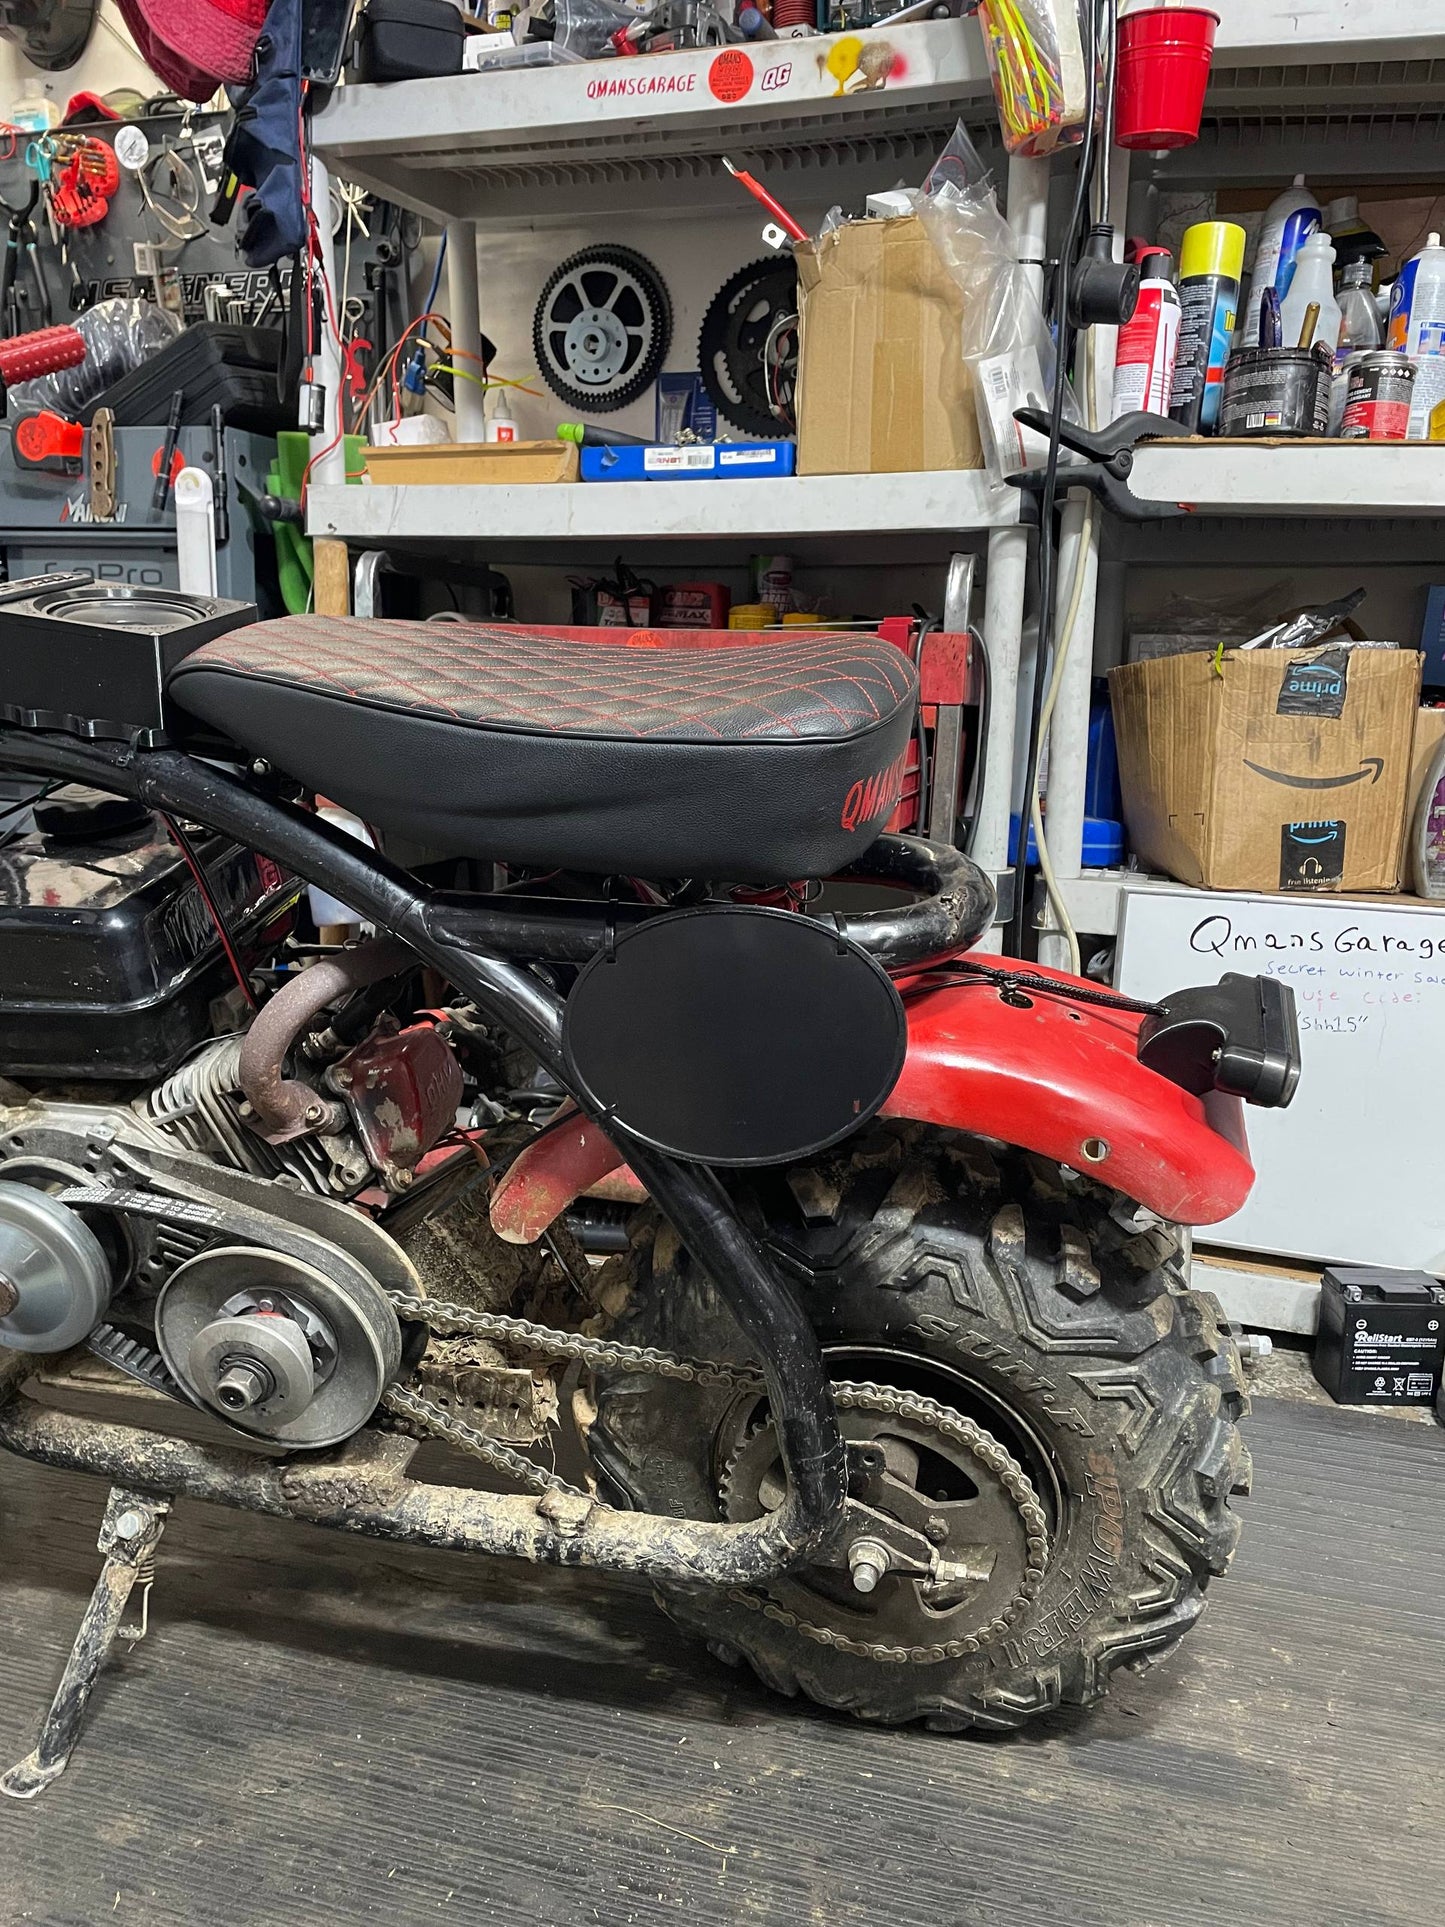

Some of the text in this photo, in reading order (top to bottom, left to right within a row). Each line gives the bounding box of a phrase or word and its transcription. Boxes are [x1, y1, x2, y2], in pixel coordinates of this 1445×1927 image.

[586, 73, 697, 100] QMANSGARAGE
[760, 62, 793, 92] QG
[1289, 680, 1341, 698] prime
[1190, 915, 1445, 959] Qmans Garage
[1339, 967, 1404, 982] winter
[124, 1201, 142, 1209] THIS
[177, 1213, 209, 1223] ENGINE
[129, 1197, 147, 1205] THIS
[182, 1208, 213, 1218] ENGINE
[134, 1192, 152, 1201] THIS
[187, 1203, 218, 1214] ENGINE
